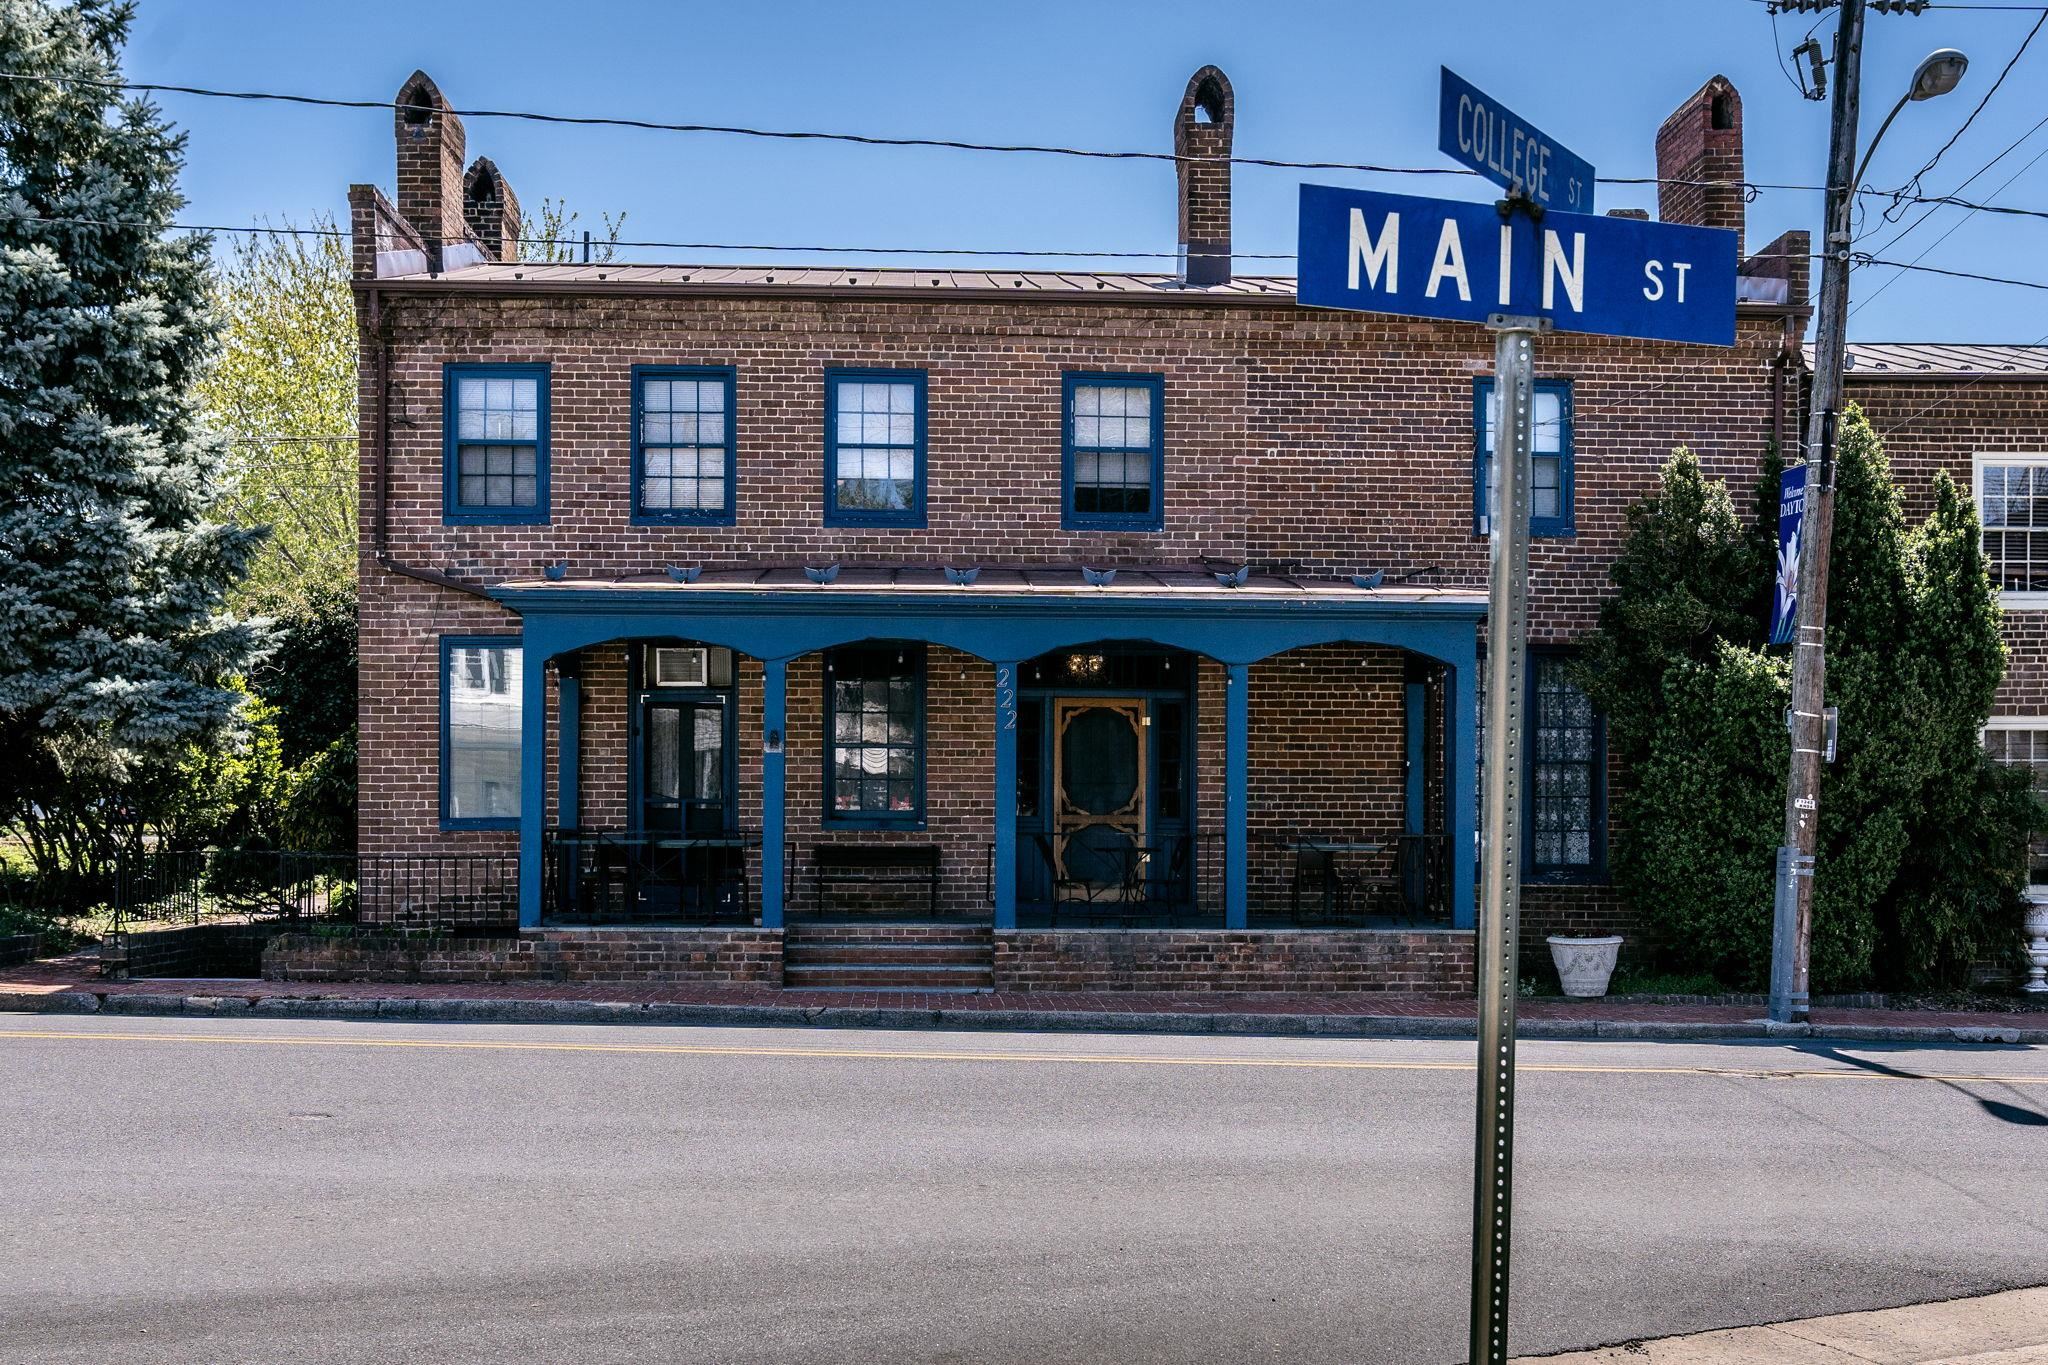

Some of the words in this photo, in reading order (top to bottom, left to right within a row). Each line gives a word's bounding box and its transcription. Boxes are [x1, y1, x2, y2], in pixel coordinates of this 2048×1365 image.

[1458, 94, 1551, 202] COLLEGE
[1568, 177, 1583, 208] ST
[1347, 208, 1586, 313] MAIN
[1642, 259, 1692, 303] ST
[1780, 499, 1804, 517] DAYTO
[1784, 486, 1804, 499] Welcome
[997, 668, 1017, 729] 222
